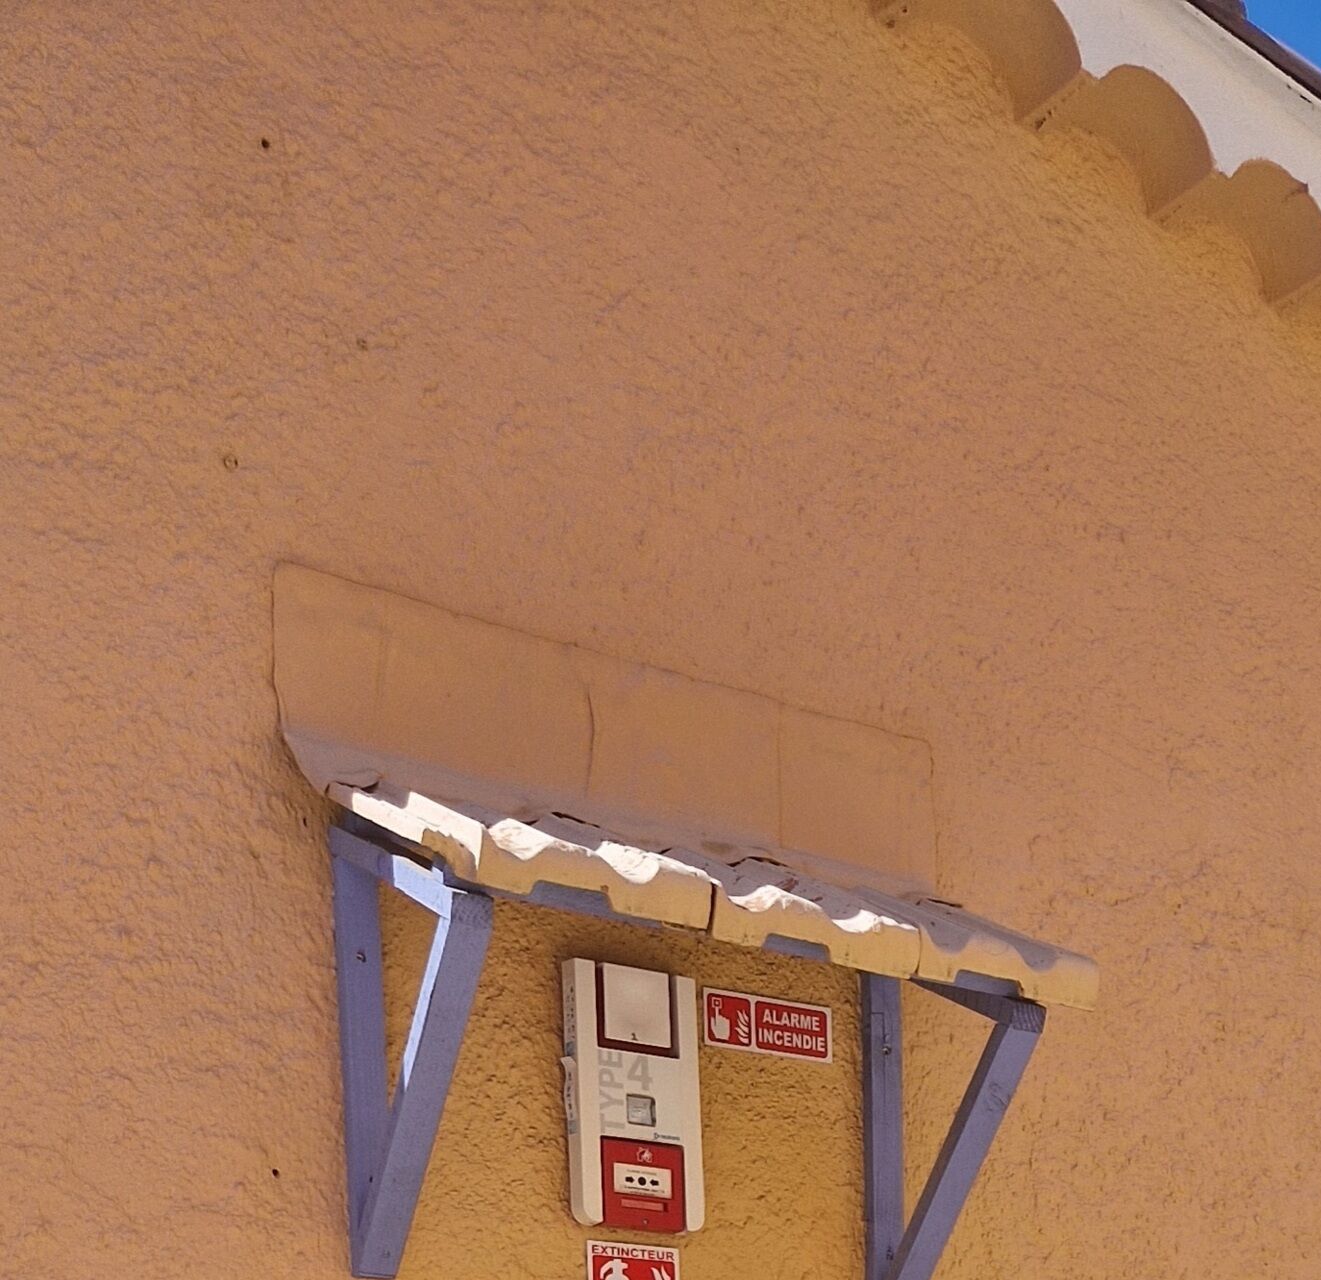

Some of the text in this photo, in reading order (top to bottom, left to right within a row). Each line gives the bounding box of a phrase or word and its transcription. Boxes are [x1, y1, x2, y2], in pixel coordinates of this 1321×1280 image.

[762, 1008, 821, 1032] ALARME
[758, 1027, 826, 1052] INCENDIE
[627, 1055, 653, 1091] 4
[599, 1049, 625, 1133] TYPE
[591, 1244, 675, 1261] EXTINCTEUR
